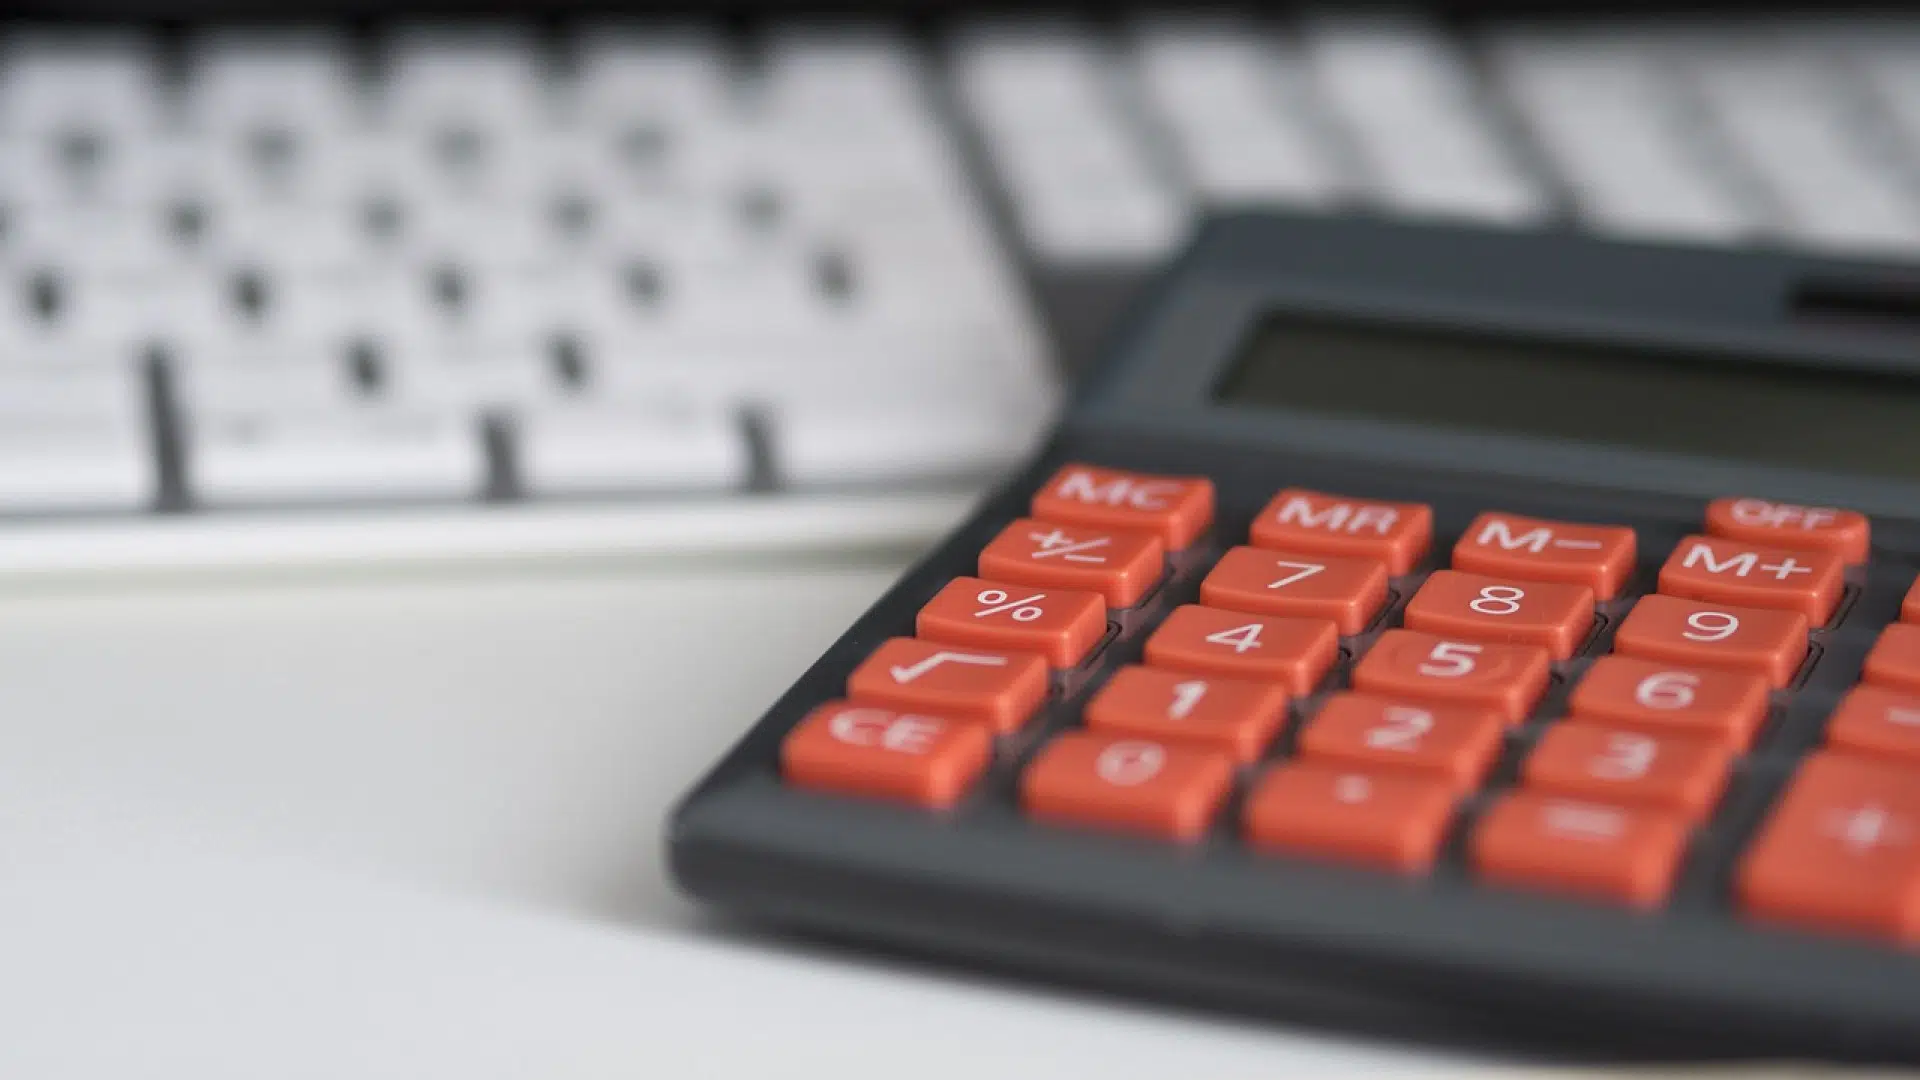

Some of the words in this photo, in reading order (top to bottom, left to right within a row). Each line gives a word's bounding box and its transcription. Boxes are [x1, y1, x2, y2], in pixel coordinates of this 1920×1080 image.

[1058, 471, 1186, 507] MC
[1278, 497, 1398, 534] MR
[1731, 499, 1837, 531] OFF
[1267, 560, 1326, 588] 7
[1682, 544, 1812, 580] M+
[974, 589, 1047, 622] %
[1470, 585, 1524, 615] 8
[1206, 623, 1263, 652] 4
[1682, 611, 1740, 641] 9
[1418, 641, 1483, 676] 5
[1168, 680, 1208, 719] 1
[1636, 672, 1699, 709] 6
[828, 707, 951, 754] CE
[1366, 707, 1435, 751] 2
[1095, 740, 1166, 786] 0
[1591, 733, 1657, 779] 3
